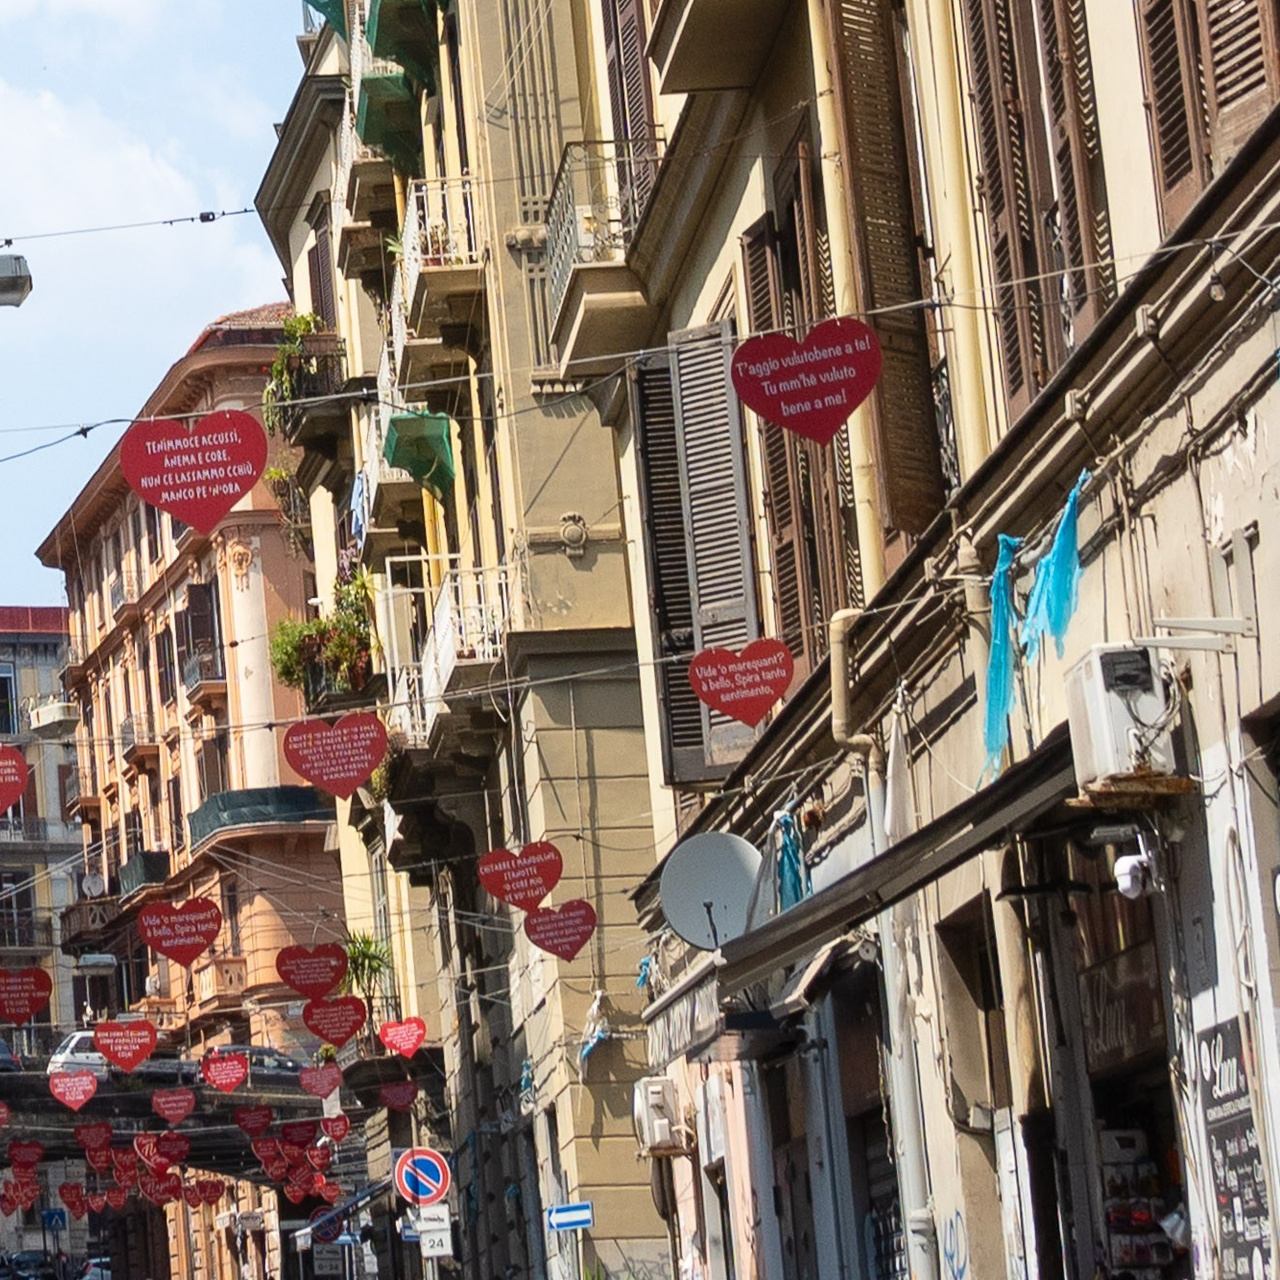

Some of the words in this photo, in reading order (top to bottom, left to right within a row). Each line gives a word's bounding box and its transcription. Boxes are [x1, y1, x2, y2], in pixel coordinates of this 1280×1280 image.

[845, 343, 852, 354] a
[762, 381, 777, 396] Tu
[781, 401, 811, 416] bene
[815, 399, 822, 408] a
[198, 452, 203, 464] E
[141, 475, 160, 489] NUN
[163, 472, 173, 486] CE
[175, 465, 224, 484] LASSAMMO
[196, 485, 207, 499] PE
[696, 666, 717, 678] Vide
